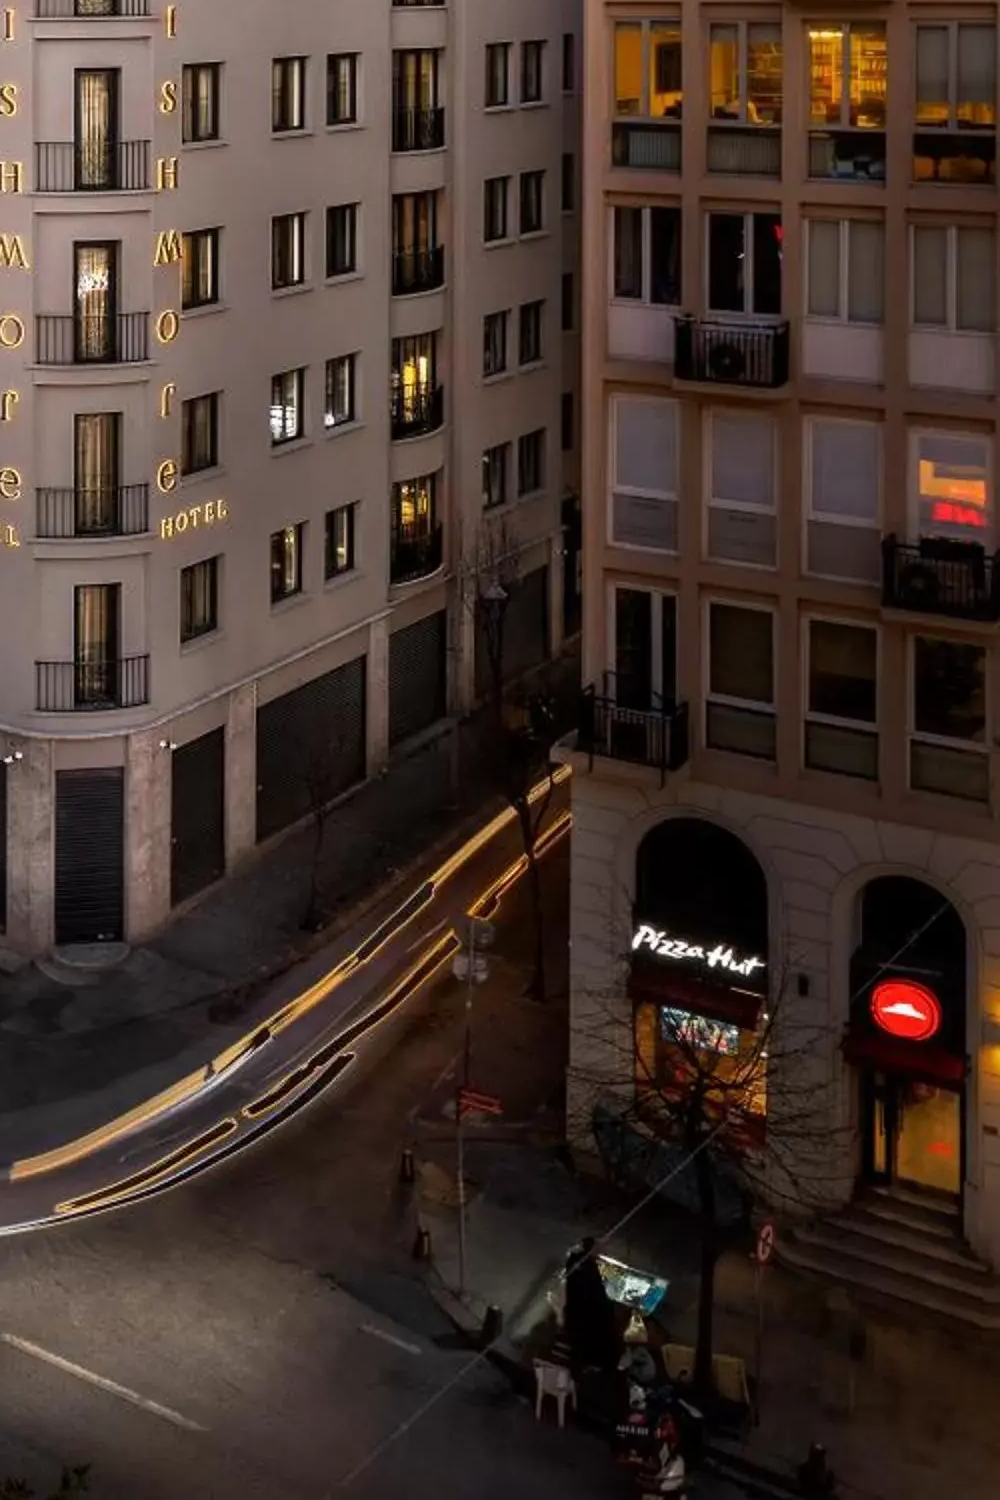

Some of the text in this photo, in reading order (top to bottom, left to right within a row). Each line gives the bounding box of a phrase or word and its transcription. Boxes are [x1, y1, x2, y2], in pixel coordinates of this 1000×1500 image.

[160, 498, 228, 540] HOTEL
[631, 924, 765, 977] Pizza Hut
